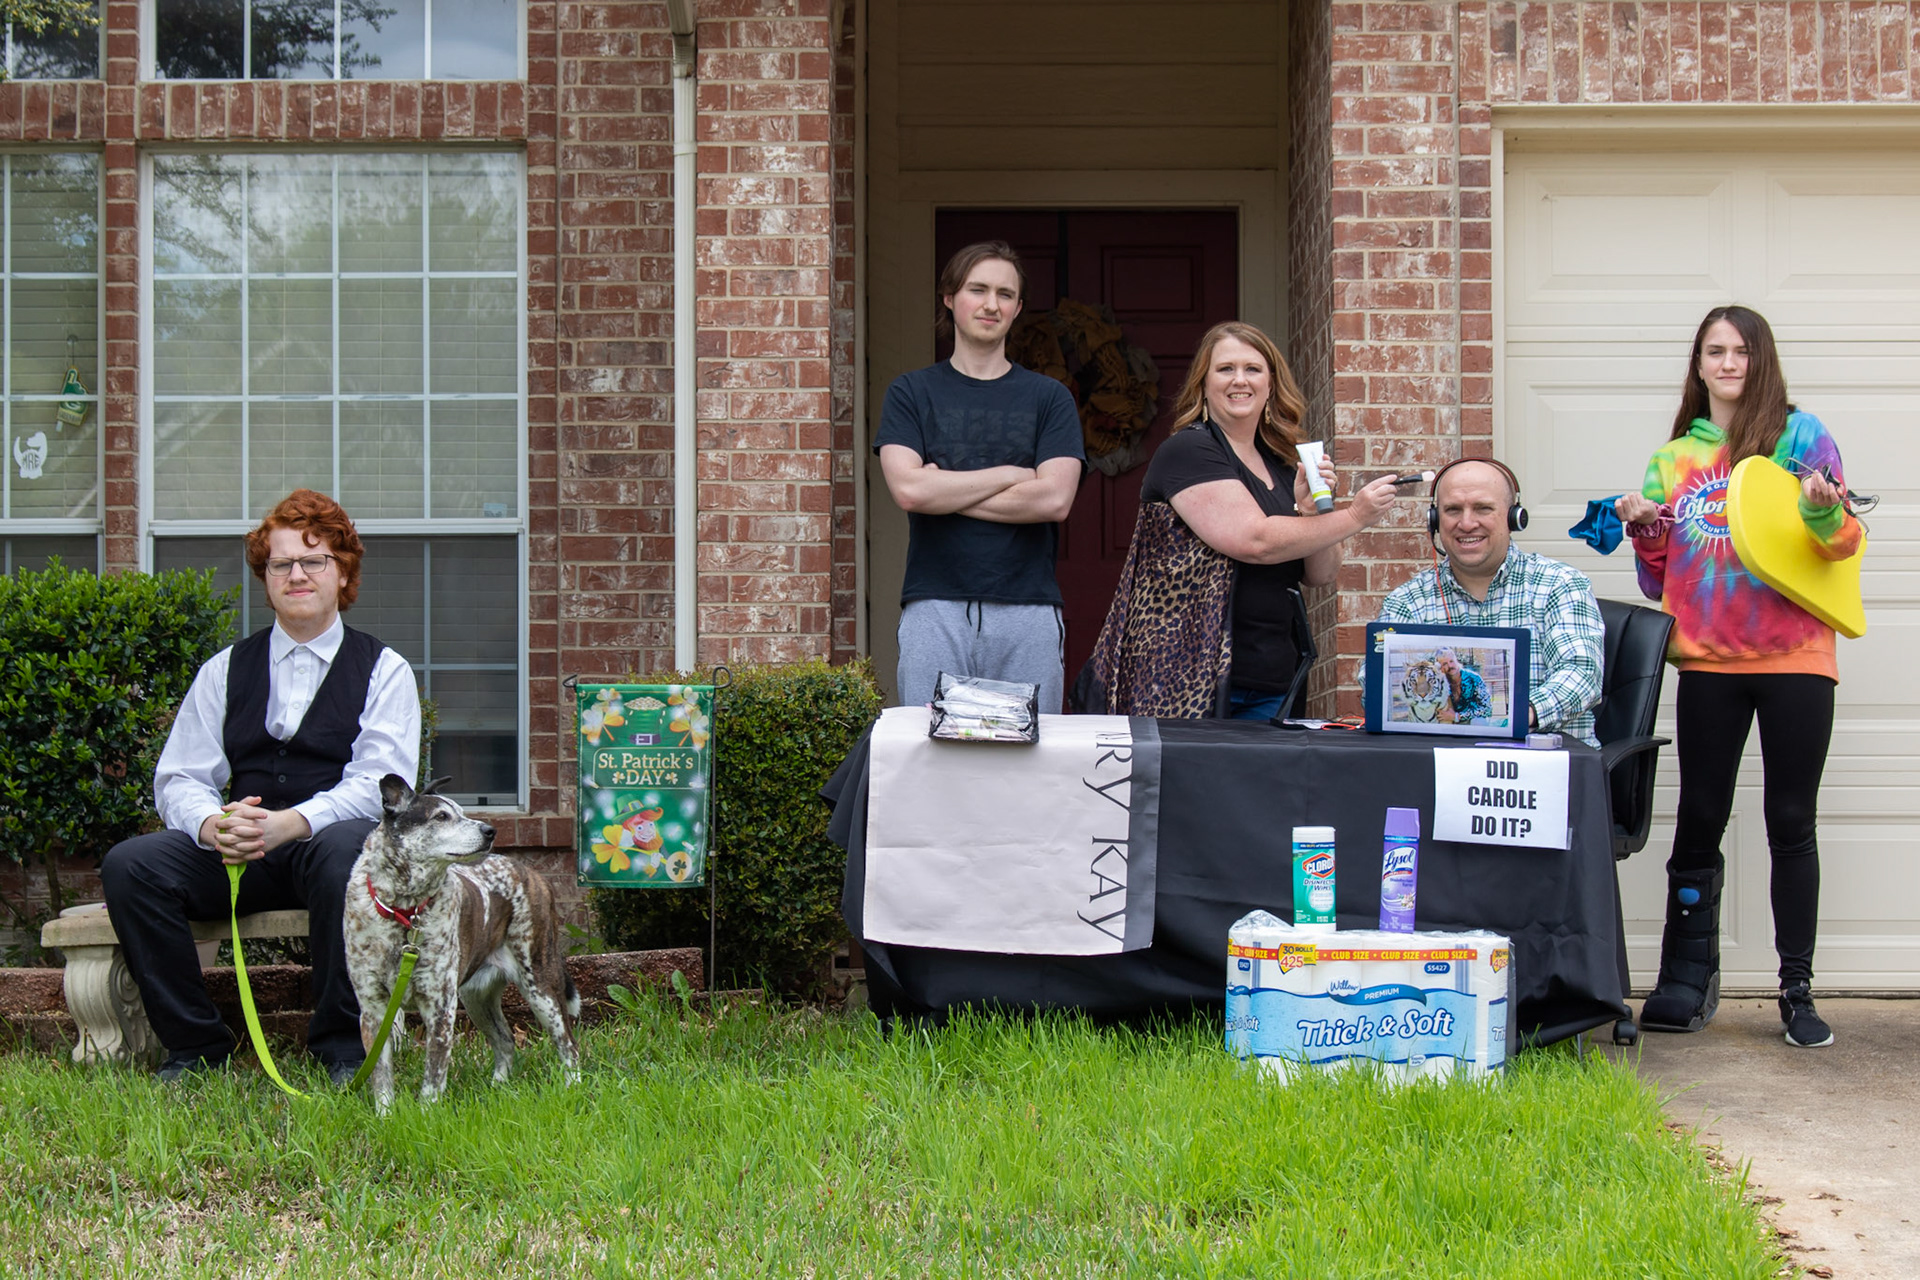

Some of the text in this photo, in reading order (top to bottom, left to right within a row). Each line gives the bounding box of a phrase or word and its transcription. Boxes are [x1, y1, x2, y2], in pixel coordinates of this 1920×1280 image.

[1706, 482, 1728, 492] ROC
[1674, 496, 1727, 524] Color
[598, 752, 618, 769] St.
[625, 769, 665, 785] DAY
[1486, 760, 1519, 780] DID
[1467, 786, 1537, 810] CAROLE
[1471, 815, 1532, 838] DO IT?
[1077, 730, 1132, 941] RY KAY
[1385, 850, 1414, 870] Lysol
[1282, 945, 1295, 955] 30
[1331, 950, 1468, 960] CLUB SIZE CLUB SIZE CLUB SIZE
[1280, 956, 1304, 969] 425
[1330, 979, 1359, 992] Willow
[1364, 987, 1400, 1001] PREMIUM
[1297, 1008, 1455, 1047] Thick & Soft
